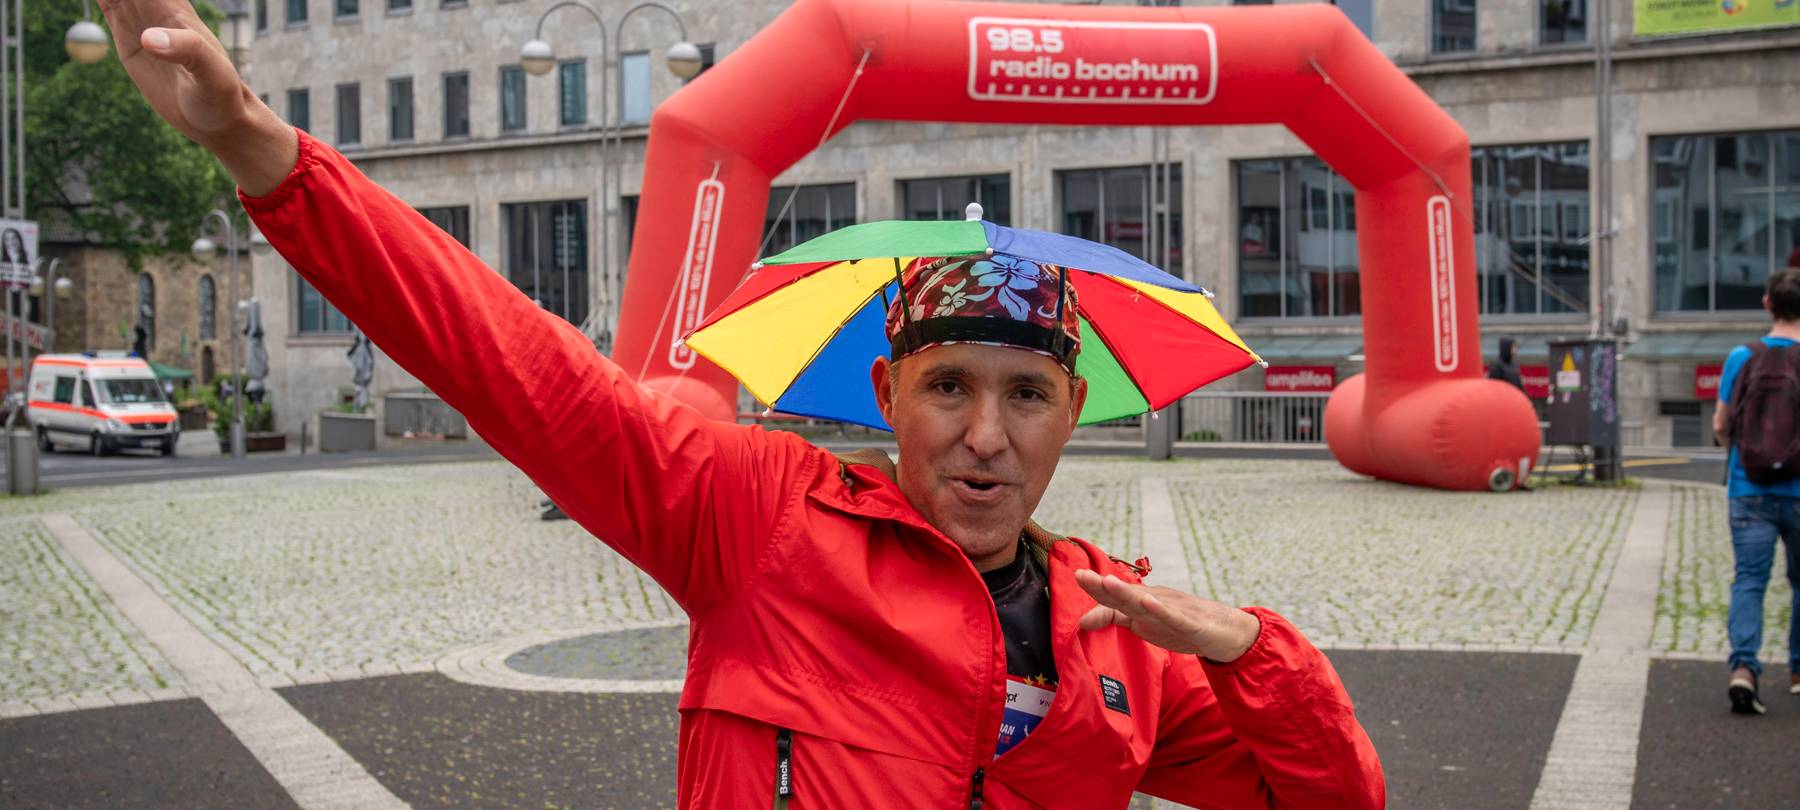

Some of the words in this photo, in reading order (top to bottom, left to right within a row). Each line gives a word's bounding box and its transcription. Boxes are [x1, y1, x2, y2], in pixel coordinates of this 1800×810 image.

[987, 27, 1064, 53] 98.5
[990, 56, 1070, 79] radio
[1075, 58, 1198, 81] bochum
[1266, 370, 1333, 390] amplifon
[779, 759, 788, 794] Bench.
